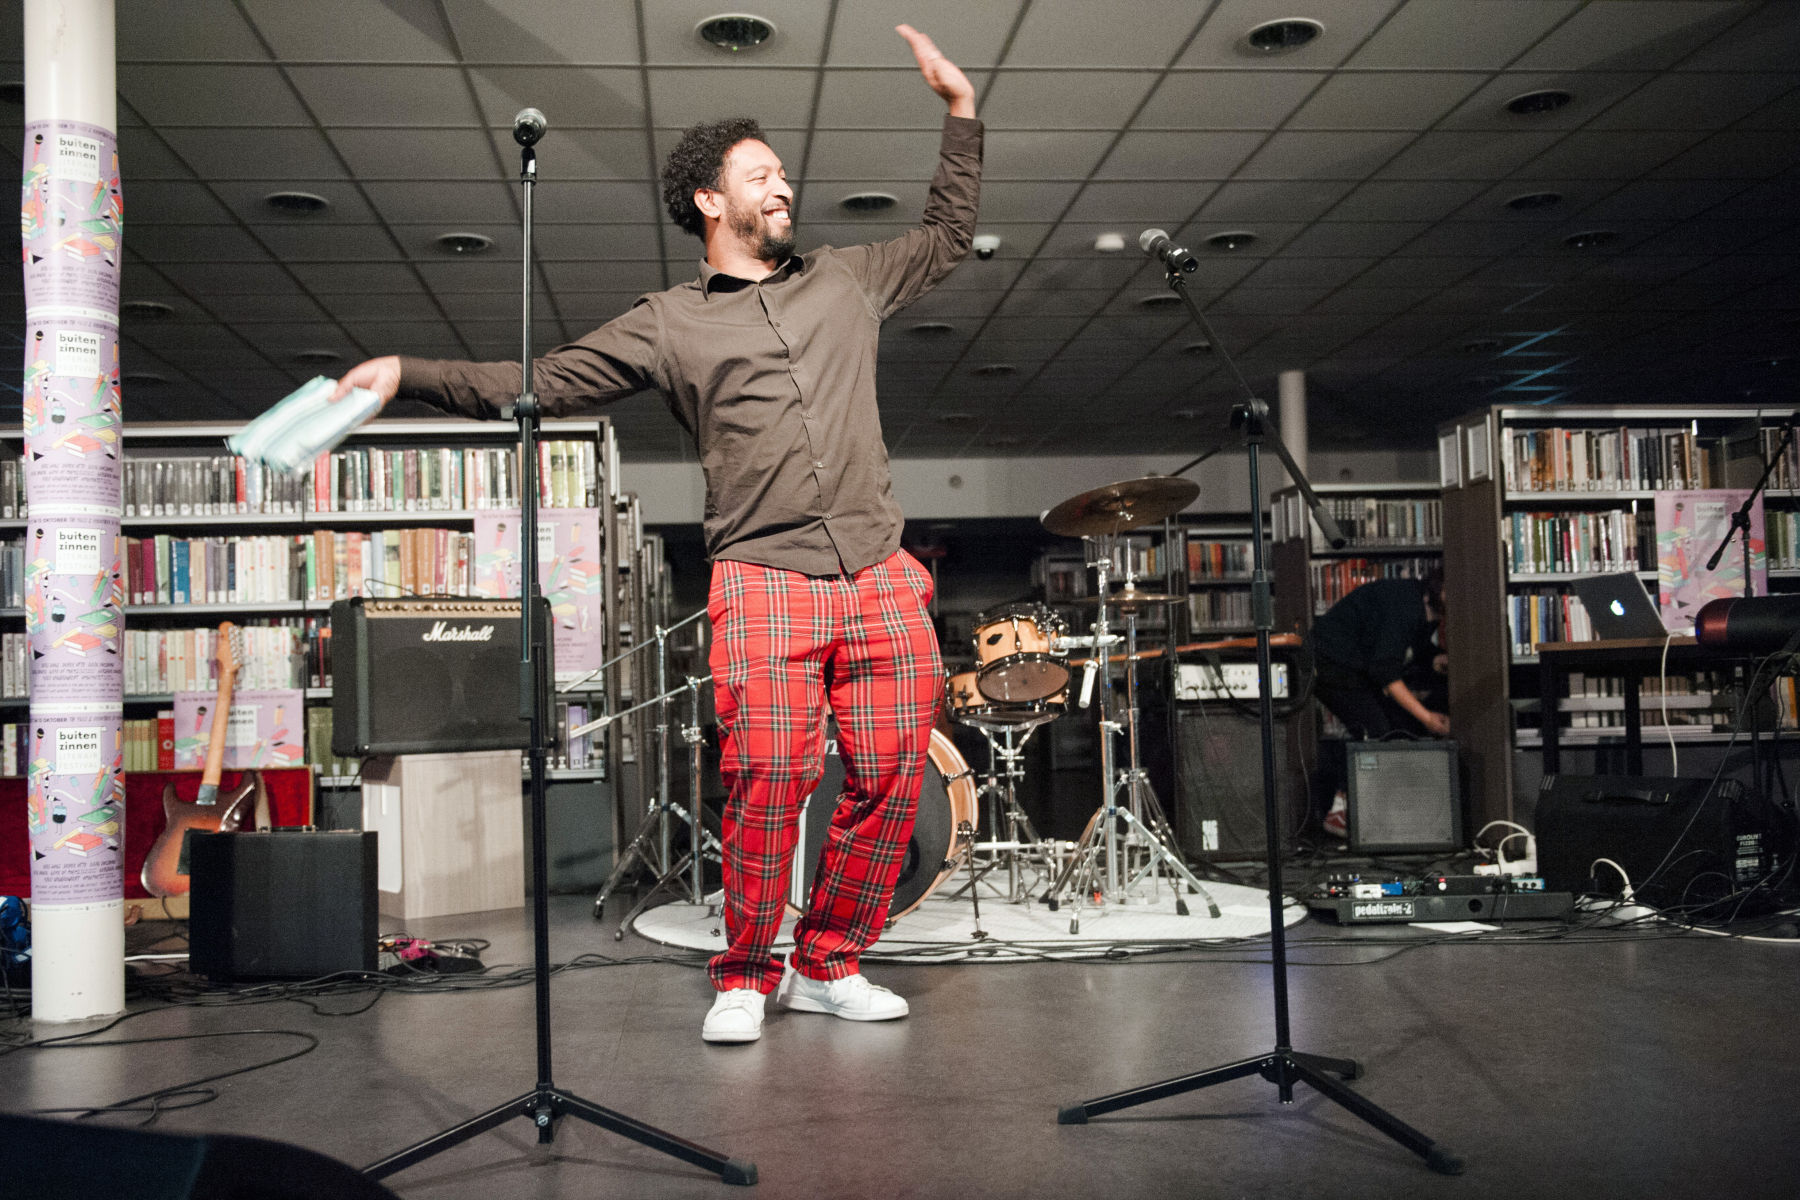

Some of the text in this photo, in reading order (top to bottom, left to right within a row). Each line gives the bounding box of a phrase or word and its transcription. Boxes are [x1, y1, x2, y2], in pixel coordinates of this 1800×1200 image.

[59, 138, 97, 151] buiten
[59, 148, 97, 160] zinnen
[59, 334, 97, 345] buiten
[59, 344, 97, 354] zinnen
[59, 531, 97, 541] buiten
[59, 542, 97, 551] zinnen
[422, 620, 495, 641] Marshall
[229, 708, 254, 716] uiten
[59, 730, 97, 740] buiten
[59, 741, 97, 750] zinnen
